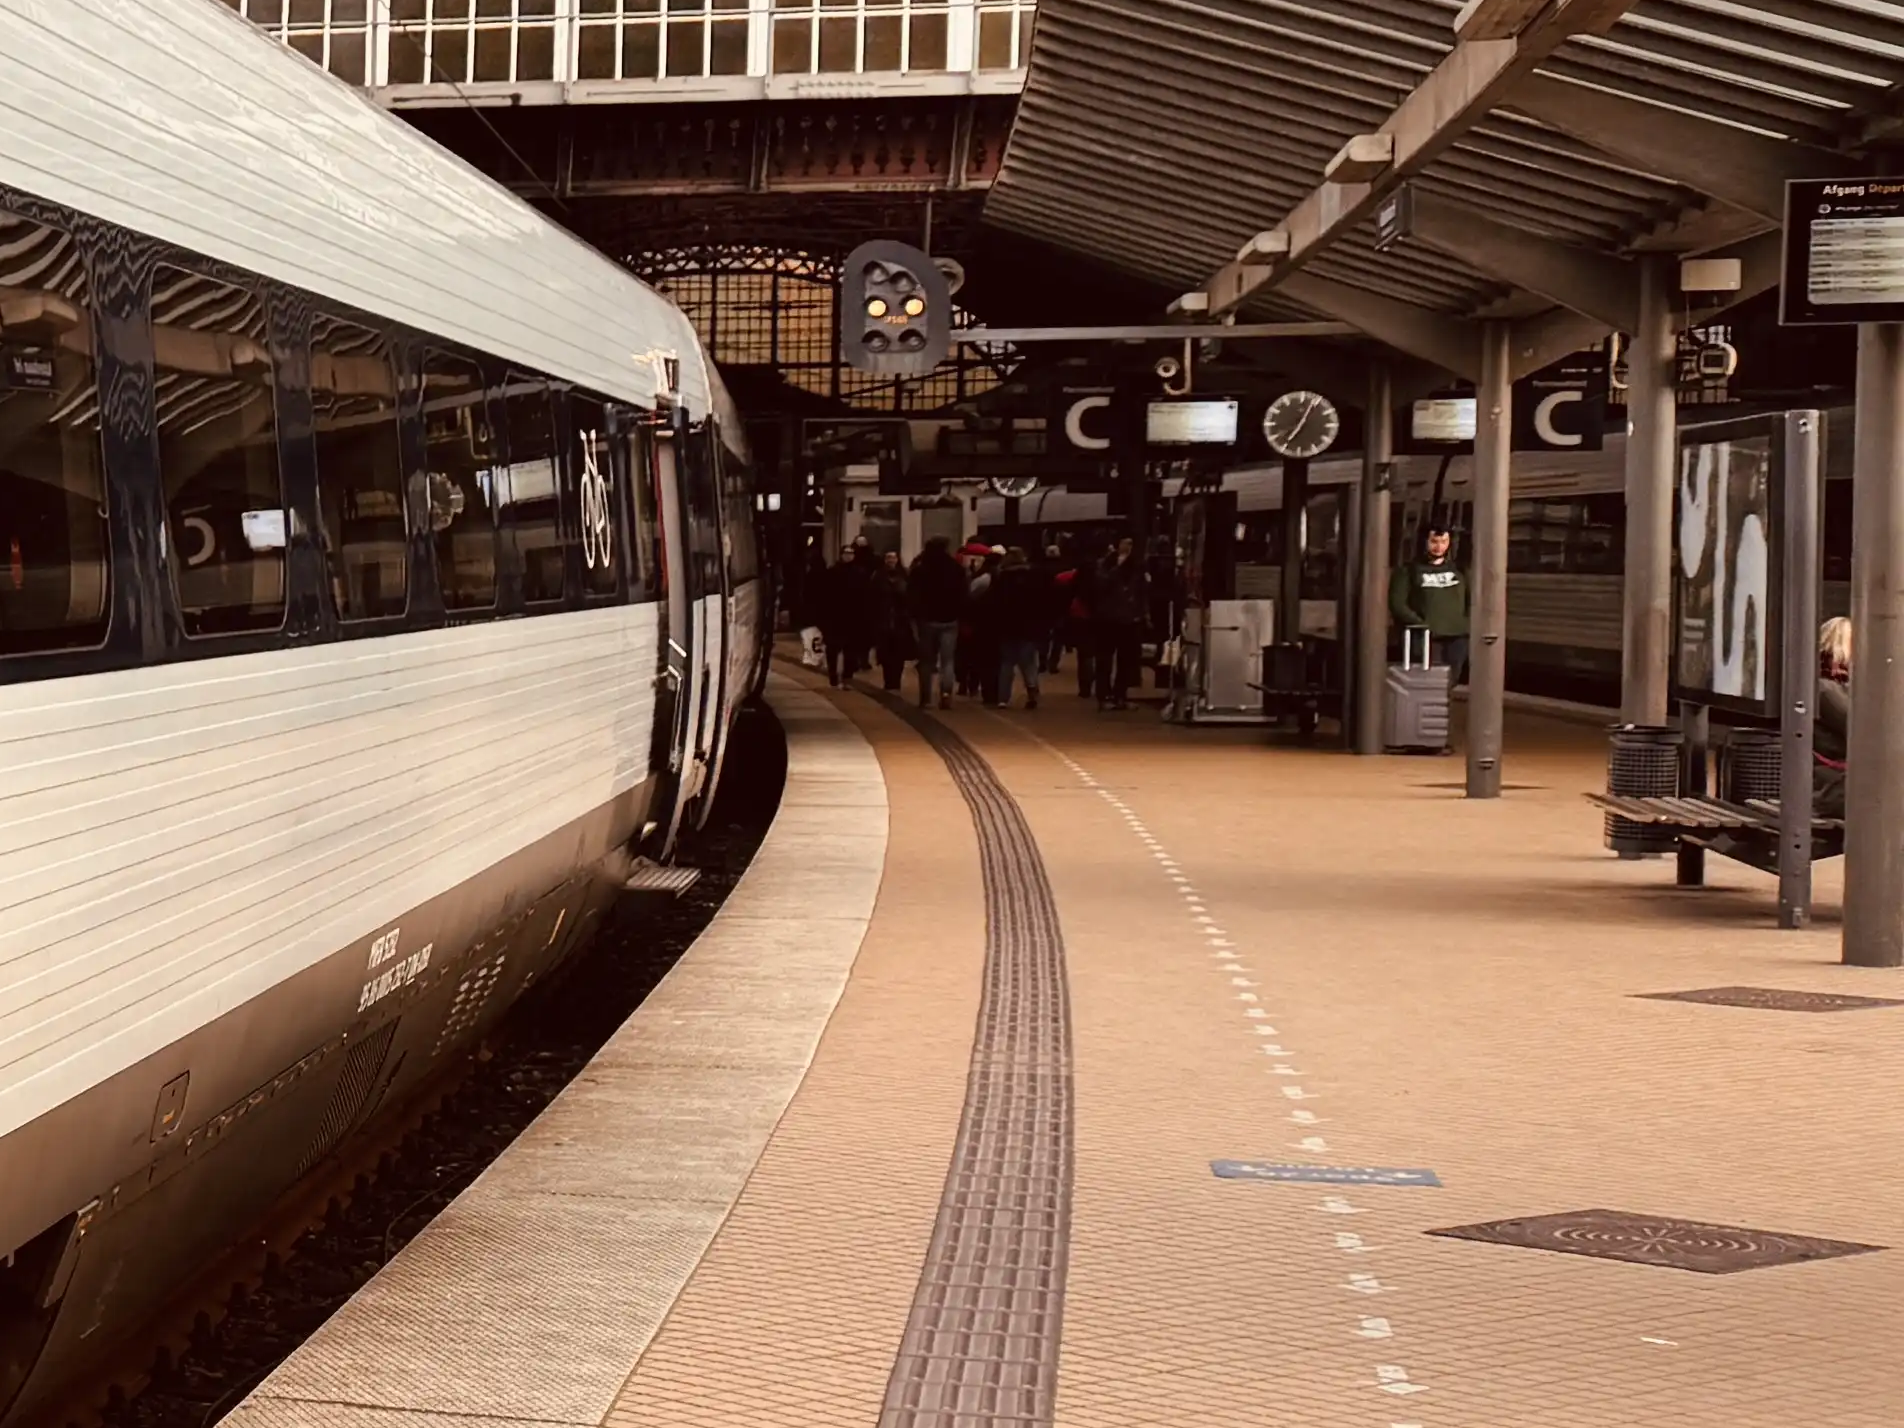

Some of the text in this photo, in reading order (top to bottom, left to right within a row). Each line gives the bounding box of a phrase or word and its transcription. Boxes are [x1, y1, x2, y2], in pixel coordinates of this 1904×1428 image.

[1823, 184, 1865, 197] Afgang
[1065, 397, 1110, 449] C
[1535, 391, 1582, 446] C
